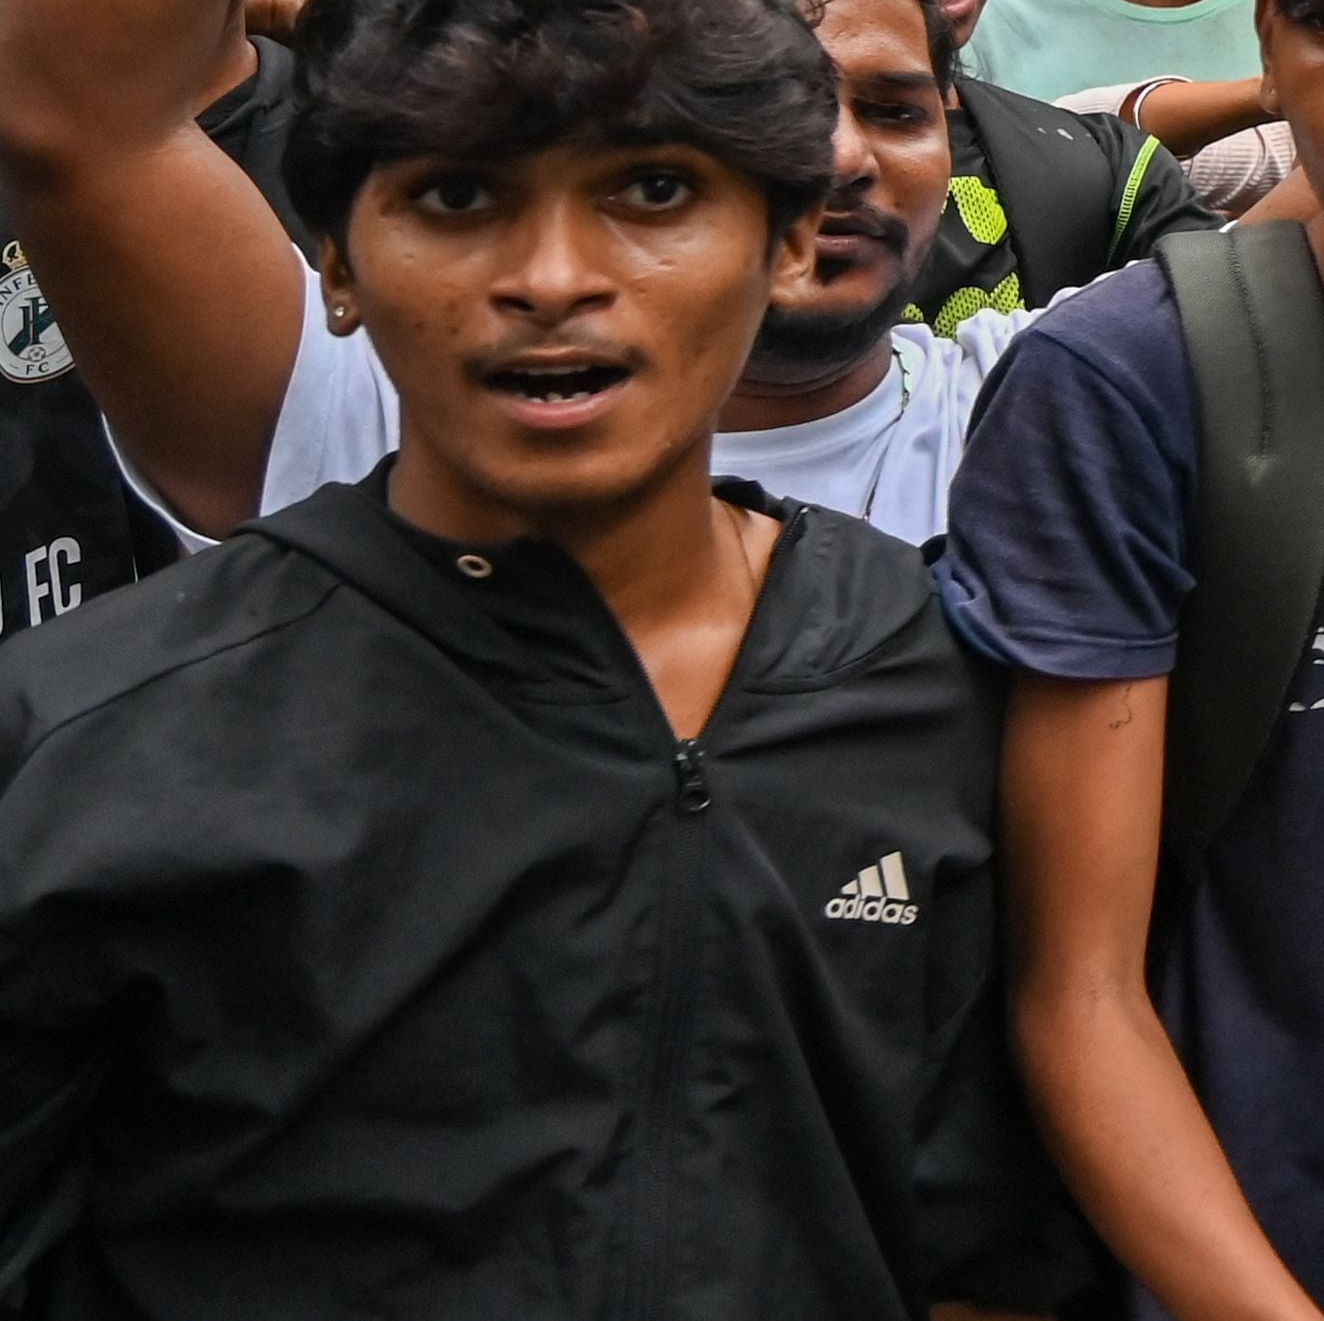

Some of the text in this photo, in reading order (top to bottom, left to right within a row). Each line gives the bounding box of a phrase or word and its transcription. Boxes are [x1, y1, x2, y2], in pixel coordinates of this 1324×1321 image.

[25, 361, 50, 376] FC
[25, 536, 82, 628] FC
[825, 894, 919, 925] adidas
